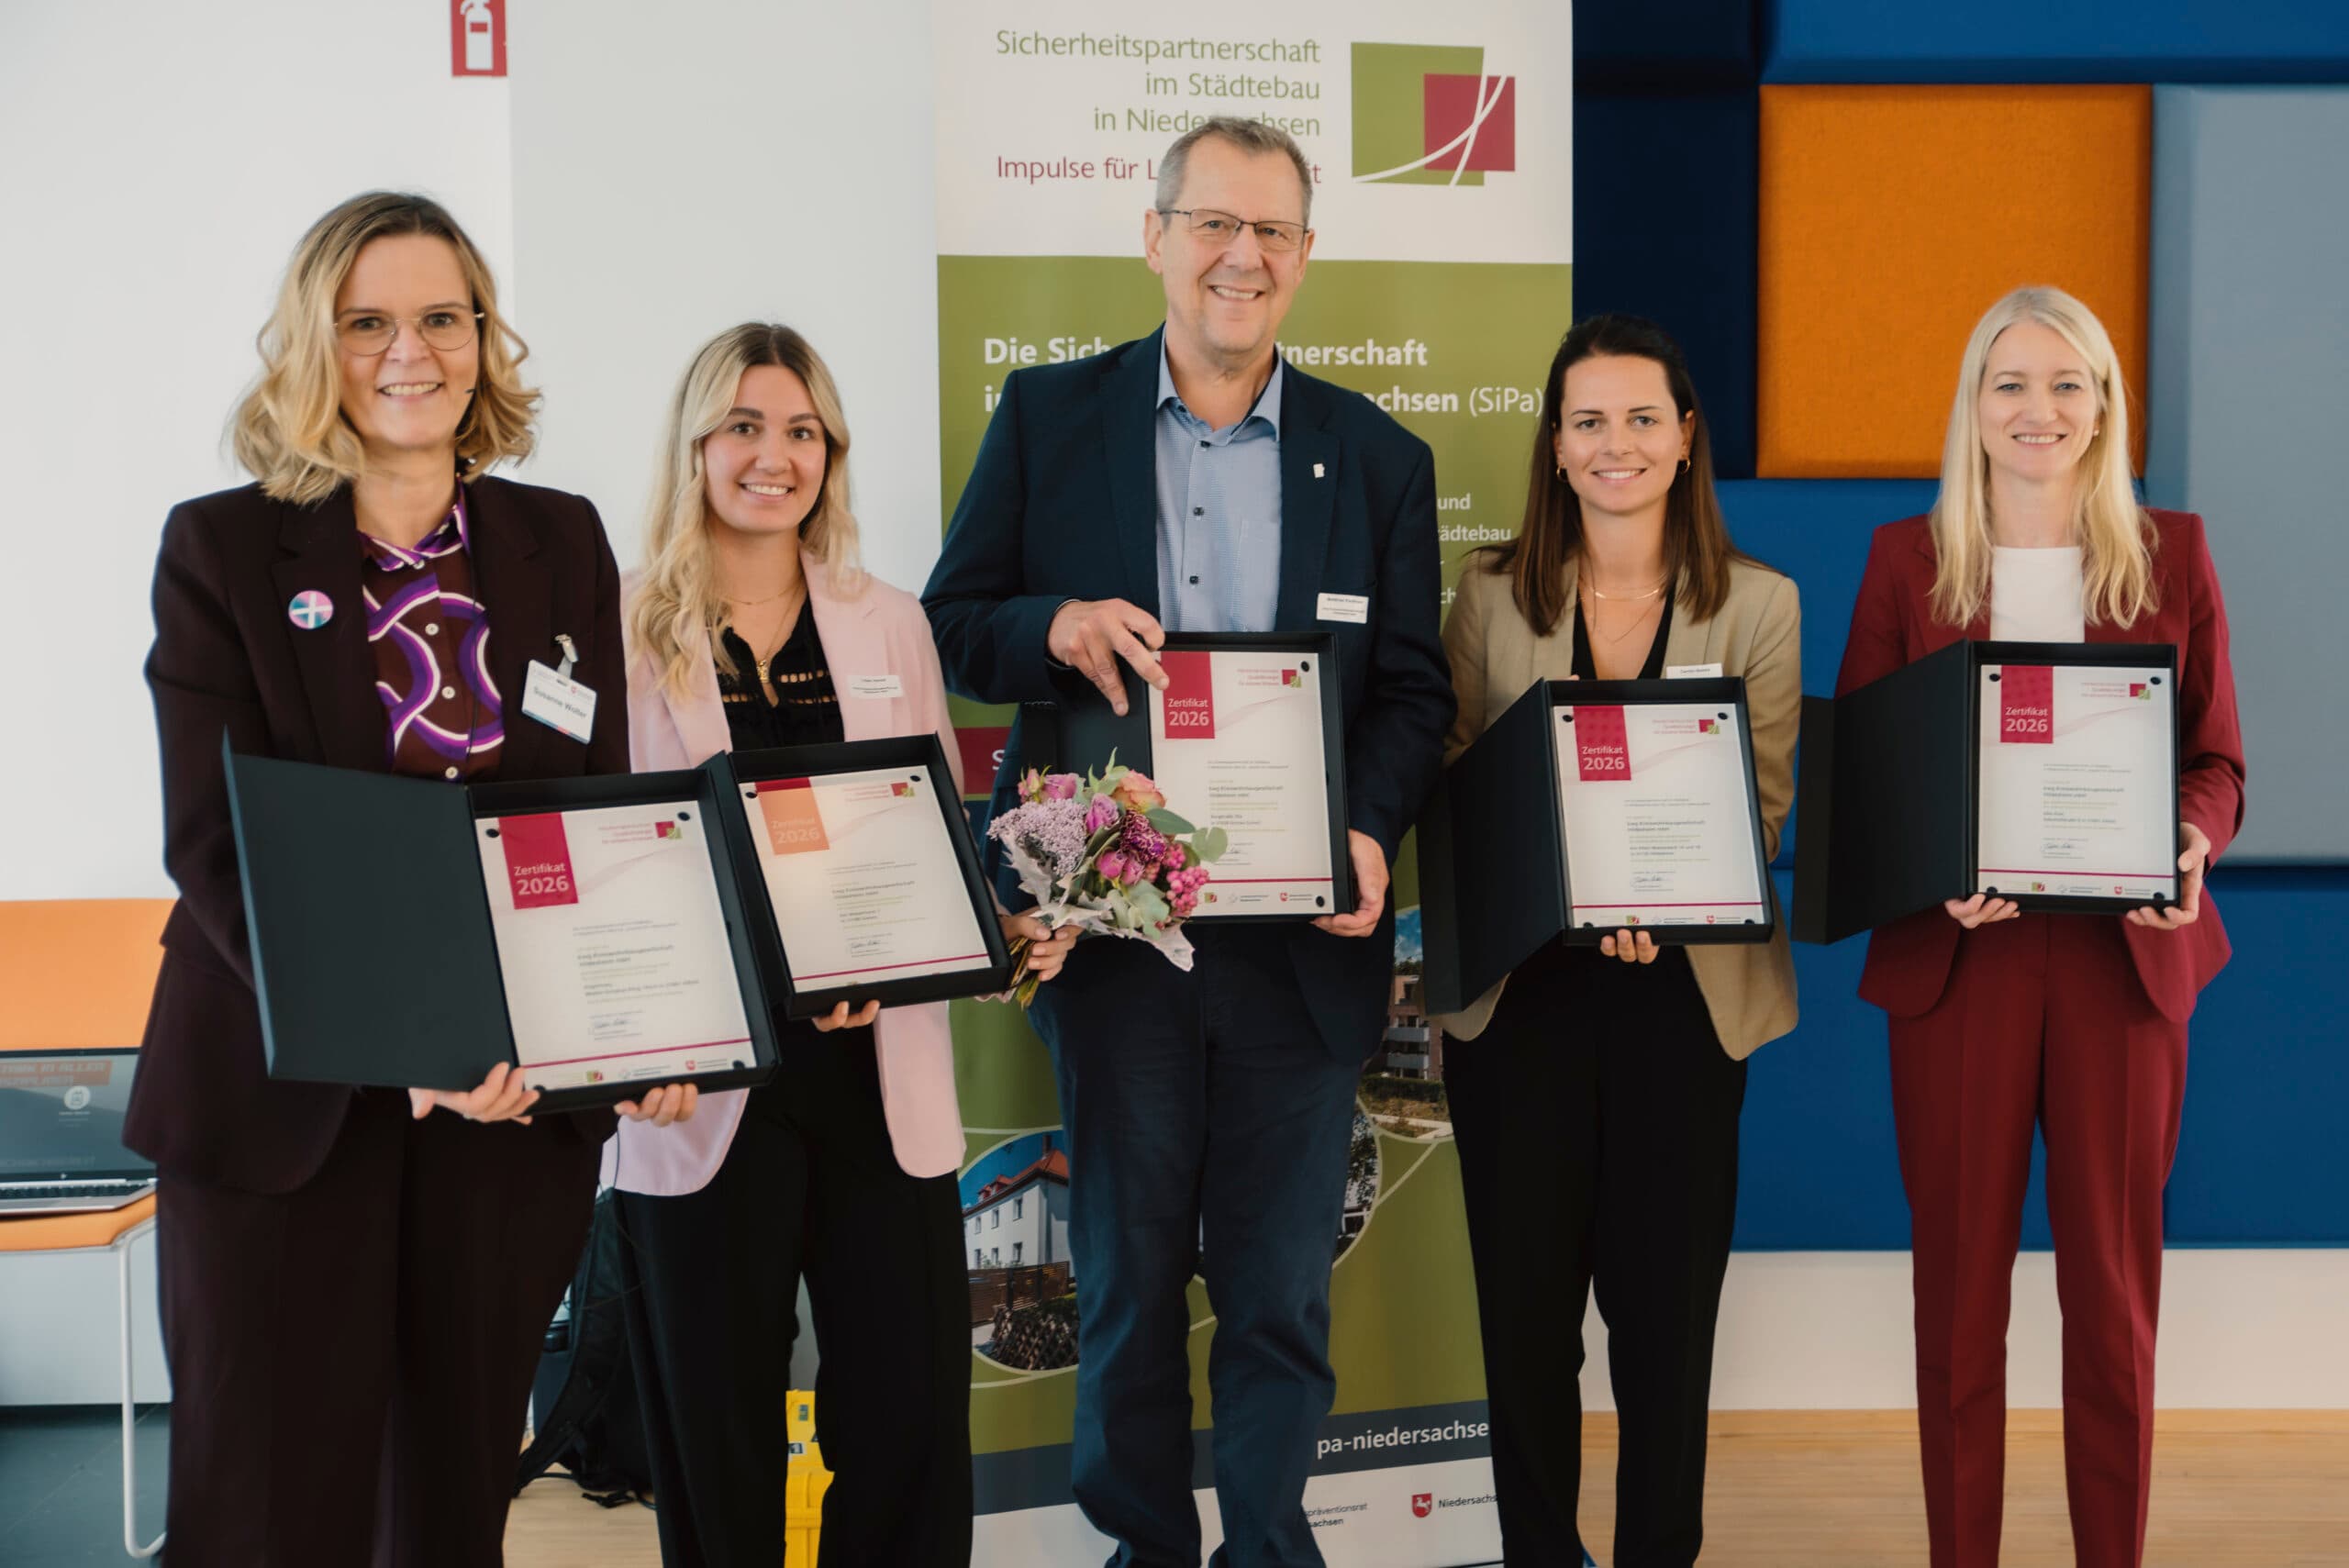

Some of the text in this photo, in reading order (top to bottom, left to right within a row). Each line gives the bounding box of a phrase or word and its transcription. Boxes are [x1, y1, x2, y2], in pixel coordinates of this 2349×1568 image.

[996, 30, 1321, 65] Sicherheitspartnerschaft
[1146, 72, 1320, 100] im Städtebau
[1094, 107, 1320, 137] in Niedehsen
[997, 156, 1095, 184] Impulse
[1103, 157, 1138, 180] für
[985, 337, 1038, 364] Die
[1469, 386, 1543, 417] (SiPa)
[1437, 493, 1471, 510] und
[1438, 524, 1511, 541] ädtebau
[1167, 697, 1208, 708] Zertifikat
[1168, 711, 1209, 727] 2026
[2005, 706, 2048, 717] Zertifikat
[2005, 718, 2048, 733] 2026
[1582, 746, 1623, 755] Zertifikat
[1583, 757, 1625, 771] 2026
[514, 862, 565, 877] Zertifikat
[516, 875, 570, 895] 2026
[1317, 1420, 1489, 1460] pa-niedersachse
